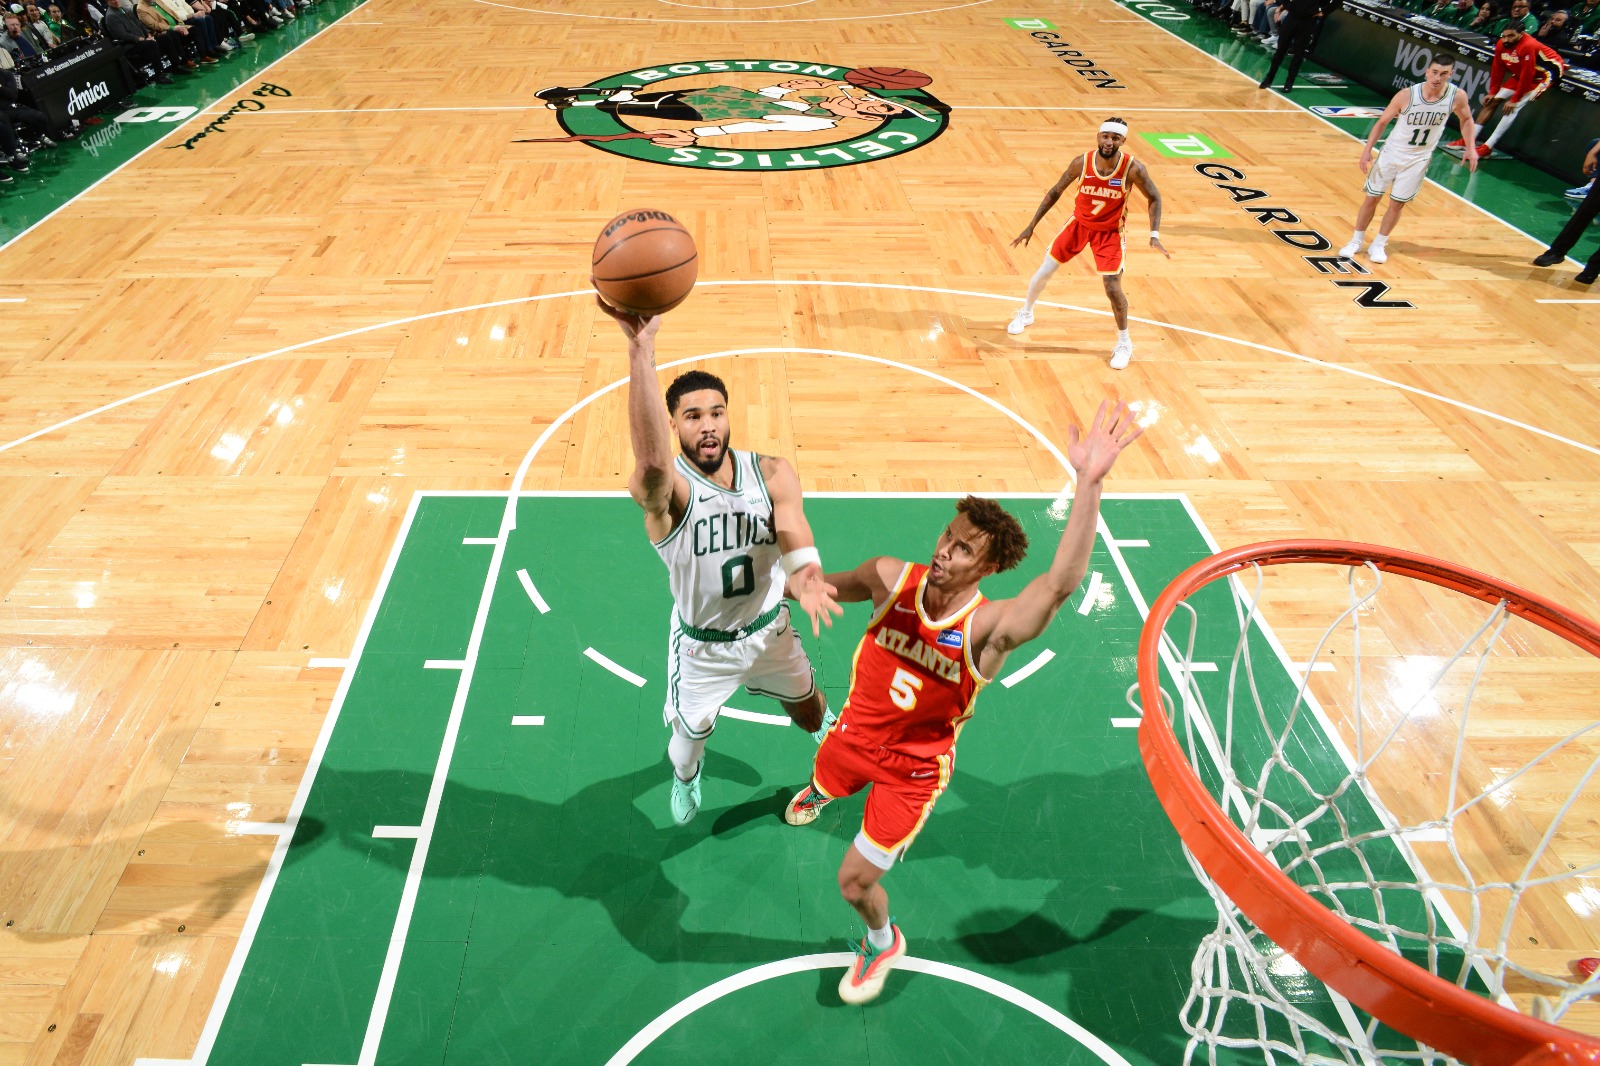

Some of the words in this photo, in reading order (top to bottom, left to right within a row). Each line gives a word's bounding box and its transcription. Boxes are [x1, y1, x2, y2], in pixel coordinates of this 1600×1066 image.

[631, 61, 838, 81] BOSTON
[1029, 31, 1129, 89] GARDEN
[68, 81, 110, 116] Amica
[1406, 111, 1446, 126] CELTICS
[668, 131, 918, 167] CELTICS
[1408, 128, 1431, 146] 11
[1080, 185, 1122, 199] ATLANTA
[1090, 199, 1107, 216] 7
[604, 210, 677, 238] Wilson
[1158, 135, 1214, 156] TD
[1193, 162, 1418, 310] GARDEN
[693, 511, 777, 557] CELTICS
[721, 554, 756, 599] 0
[874, 626, 961, 685] ATLANTA
[888, 666, 924, 711] 5
